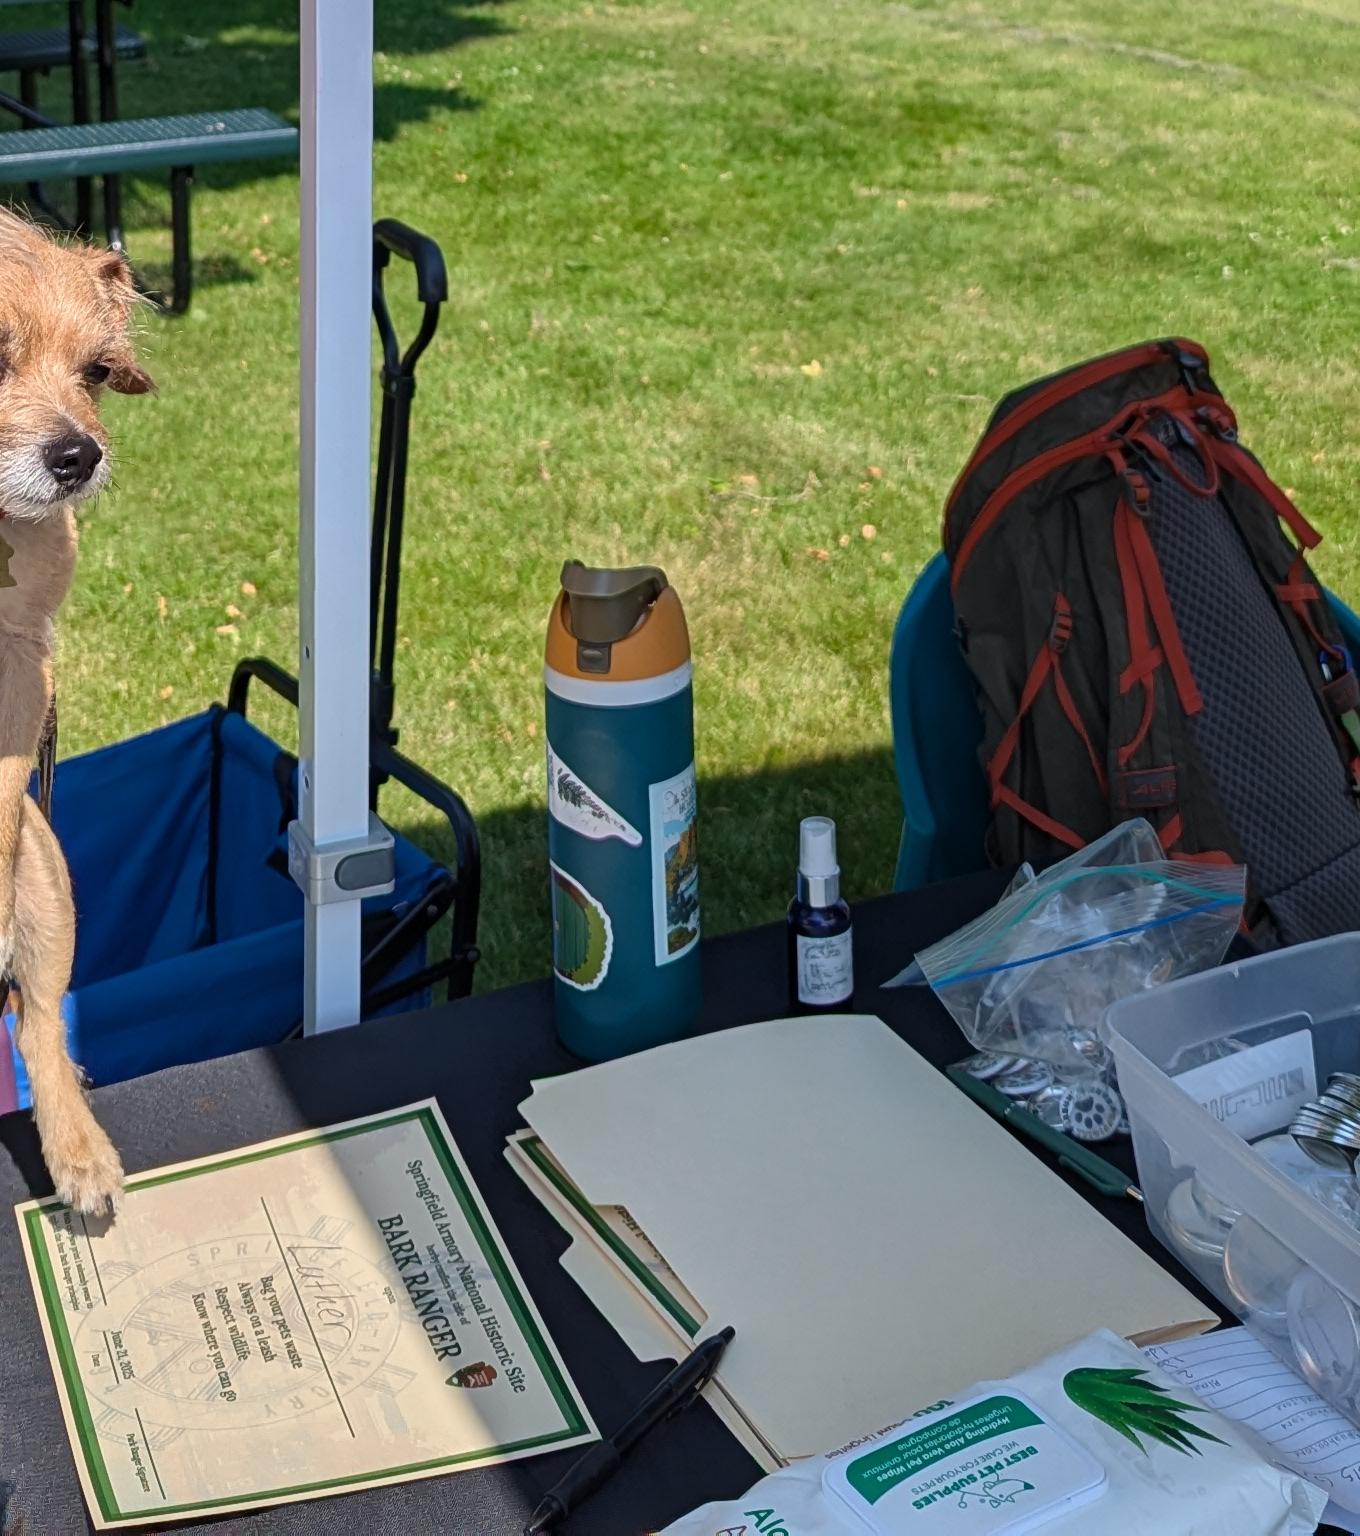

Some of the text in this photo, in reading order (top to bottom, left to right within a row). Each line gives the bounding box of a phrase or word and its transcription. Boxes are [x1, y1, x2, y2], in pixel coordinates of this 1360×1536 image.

[377, 1213, 463, 1362] BARK RANGER
[408, 1159, 527, 1394] Springfield Armory National Historic Site
[192, 1292, 237, 1403] Know where you can go
[214, 1286, 252, 1362] Respect wildlife
[237, 1281, 278, 1363] Always on a leash
[260, 1275, 303, 1370] Bag your pets waste
[461, 1315, 472, 1326] of
[110, 1329, 122, 1350] June
[119, 1360, 136, 1380] 2025
[126, 1432, 151, 1494] Park Ranger Signature
[876, 1415, 1011, 1484] Hydrating Aloe Vera Pet Wipes
[896, 1416, 961, 1452] de compagnie
[901, 1442, 923, 1459] pour
[923, 1421, 974, 1449] hydratantes
[861, 1455, 902, 1480] animaux
[911, 1440, 1019, 1496] WE CARE FOR YOUR PETS
[911, 1445, 1039, 1511] BEST PET SUPPLIES
